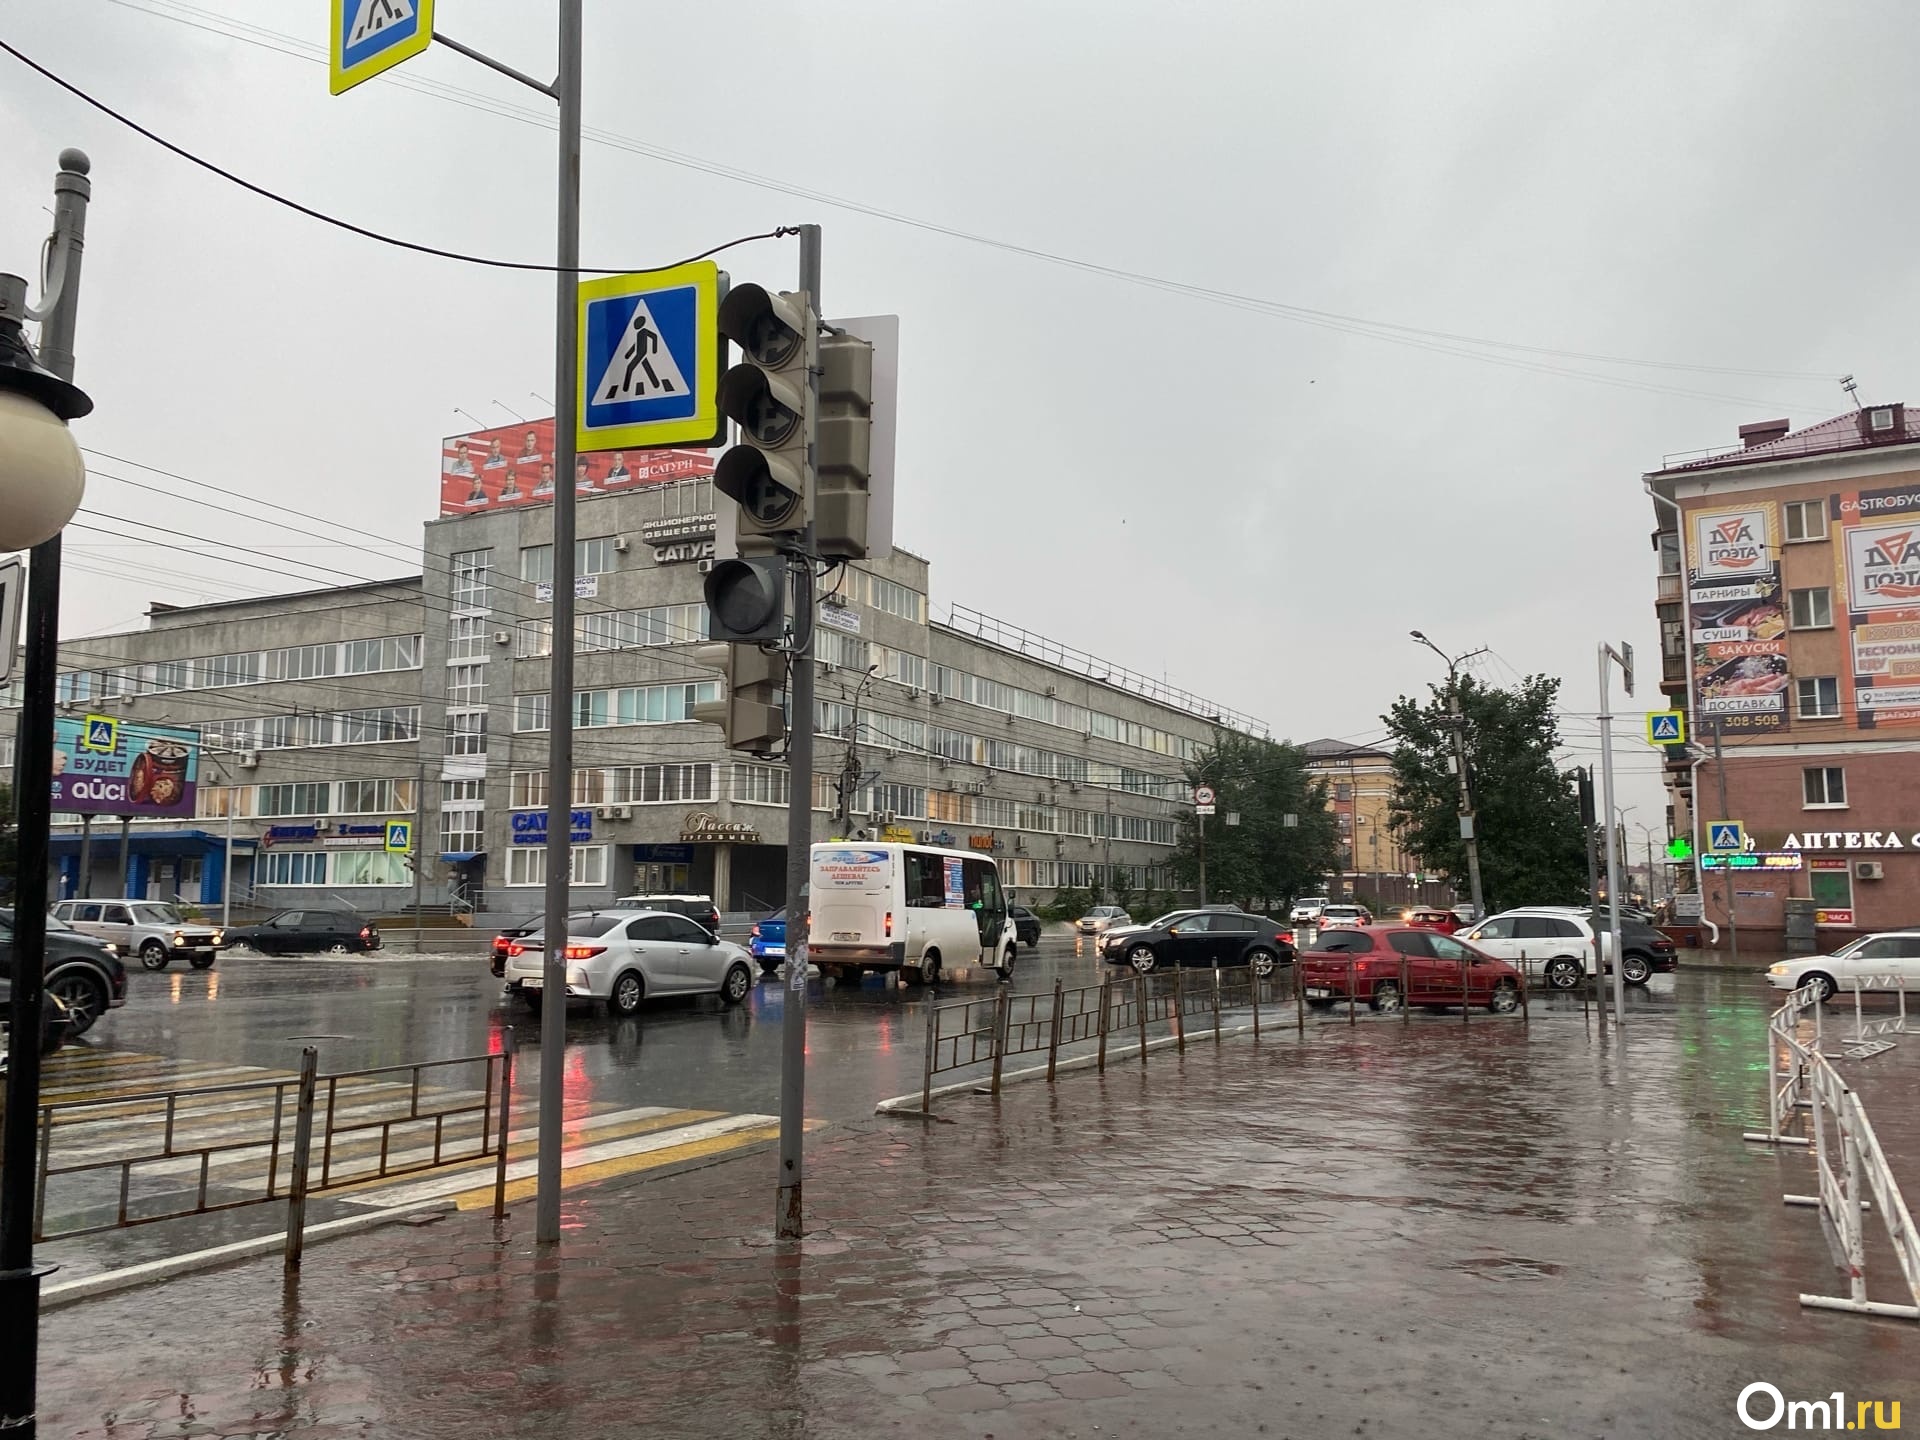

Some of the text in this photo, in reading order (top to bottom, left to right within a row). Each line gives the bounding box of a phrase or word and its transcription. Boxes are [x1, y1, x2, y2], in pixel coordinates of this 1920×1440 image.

[650, 459, 693, 475] САТУРН
[643, 513, 717, 529] АКЦИОНЕРНО
[645, 523, 717, 539] ОБЩЕСТВО
[653, 541, 714, 562] САТУР
[1709, 546, 1758, 562] ПОЭТА
[1697, 587, 1750, 600] ГАРНИРЫ
[1702, 629, 1741, 641] СУШИ
[1718, 642, 1780, 656] ЗАКУСКИ
[1708, 698, 1778, 713] ДОСТАВКА
[1725, 714, 1780, 728] 308-508
[73, 758, 127, 774] БУДЕТ
[512, 810, 592, 832] САТРН
[1782, 832, 1904, 849] АПТЕКА
[1829, 913, 1850, 922] ЧАСА
